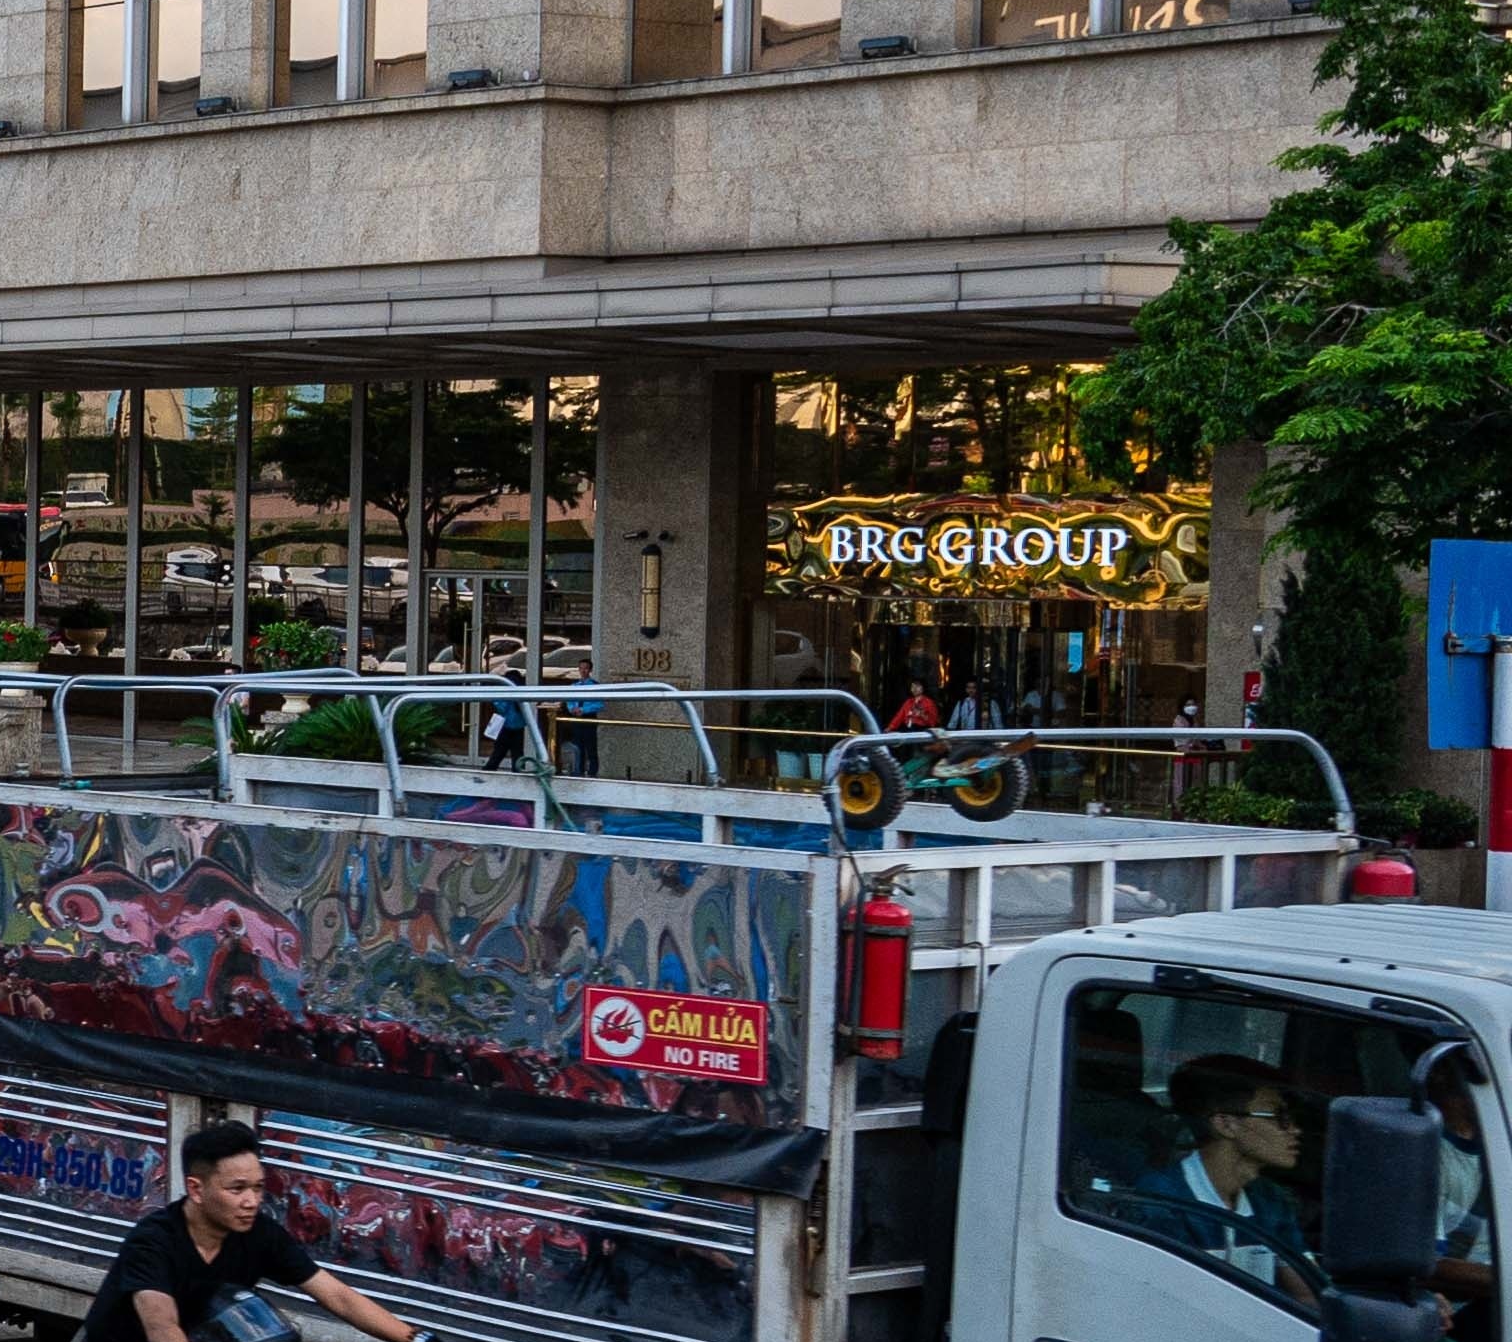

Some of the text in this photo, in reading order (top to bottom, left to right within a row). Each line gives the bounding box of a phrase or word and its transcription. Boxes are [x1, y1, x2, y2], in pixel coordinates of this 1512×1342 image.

[828, 525, 1129, 567] BRG GROUP
[632, 648, 672, 672] 198
[648, 1001, 757, 1044] CẤM LỬA
[664, 1046, 740, 1071] NO FIRE
